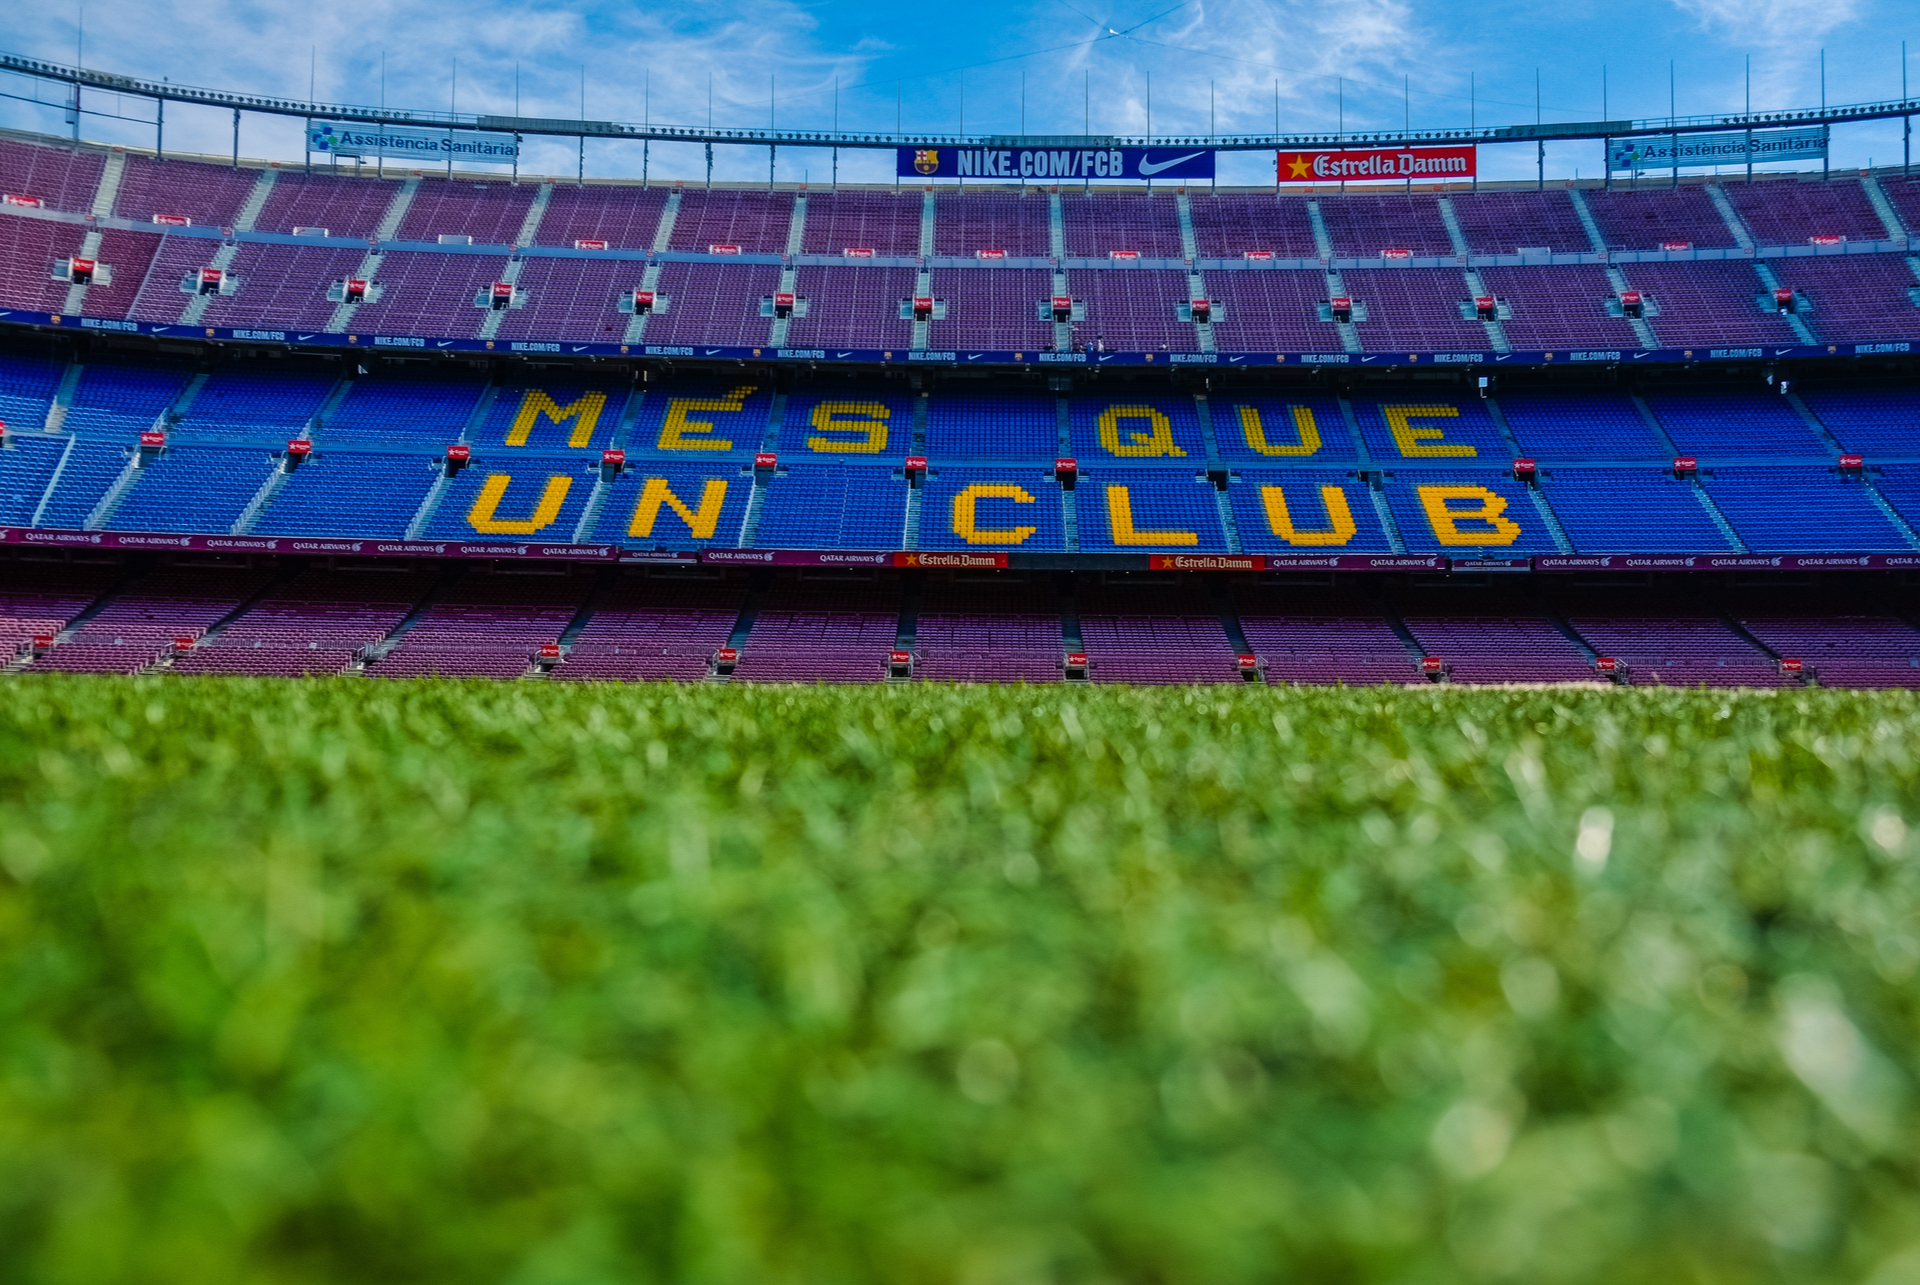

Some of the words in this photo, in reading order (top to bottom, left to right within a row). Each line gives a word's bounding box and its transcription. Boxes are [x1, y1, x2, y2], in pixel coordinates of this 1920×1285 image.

[340, 131, 438, 151] Assistència
[441, 139, 514, 156] Sanitària
[1644, 139, 1746, 159] Assistència
[1749, 136, 1828, 153] Sanitària
[957, 150, 1124, 177] NIKE.COM/FCB
[1313, 154, 1395, 177] Estrella
[1397, 153, 1467, 175] Damm
[81, 318, 137, 331] NIKE.COM/FCB
[233, 330, 285, 340] NIKE.COM/FCB
[375, 336, 424, 347] NIKE.COM/FCB
[512, 342, 560, 352] NIKE.COM/FCB
[646, 346, 693, 356] NIKE.COM/FCB
[1855, 343, 1909, 352] NIKE.COM/FCB
[778, 349, 824, 358] NIKE.COM/FCB
[909, 351, 955, 361] NIKE.COM/FCB
[1039, 353, 1086, 362] NIKE.COM/FCB
[1170, 354, 1217, 363] NIKE.COM/FCB
[1301, 354, 1349, 363] NIKE.COM/FCB
[1434, 353, 1482, 363] NIKE.COM/FCB
[1570, 351, 1620, 361] NIKE.COM/FCB
[1710, 349, 1762, 358] NIKE.COM/FCB
[506, 386, 890, 453] MÉS
[1098, 406, 1477, 457] QUE
[467, 475, 728, 538] UN
[953, 485, 1522, 545] CLUB
[26, 533, 54, 541] QATAR
[919, 554, 960, 565] Estrella
[960, 553, 995, 566] Damm
[1175, 556, 1216, 567] Estrella
[1218, 557, 1252, 568] Damm
